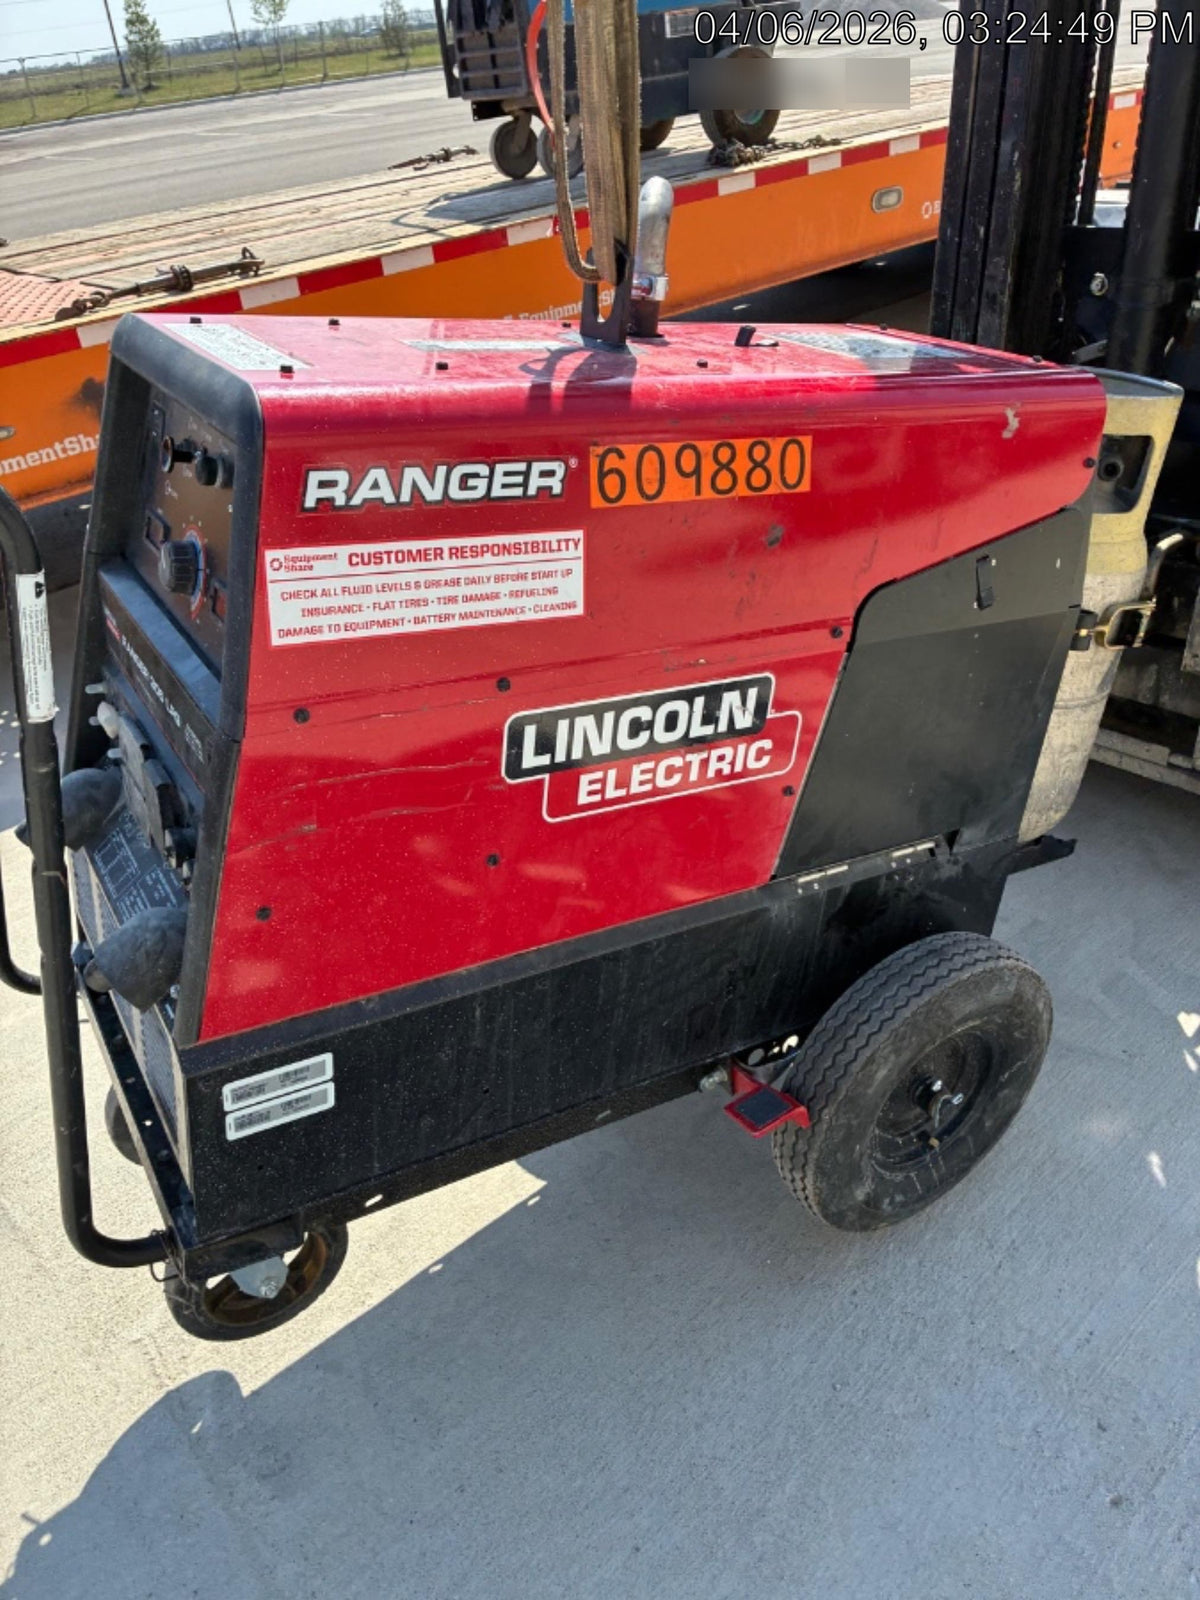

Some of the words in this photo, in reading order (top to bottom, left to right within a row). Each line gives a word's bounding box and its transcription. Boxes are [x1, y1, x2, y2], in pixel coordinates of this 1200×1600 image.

[303, 460, 566, 510] RANGER
[597, 437, 807, 505] 609880
[283, 552, 338, 564] Equipment
[283, 564, 314, 573] Share
[347, 546, 445, 568] CUSTOMER
[448, 537, 581, 561] RESPONSIBILITY
[280, 588, 318, 601] CHECK
[320, 587, 339, 599] ALL
[341, 584, 373, 596] FLUID
[375, 580, 411, 593] LEVELS
[414, 580, 421, 590] &
[424, 577, 462, 589] GREASE
[464, 575, 492, 586] DAILY
[493, 572, 529, 584] BEFORE
[531, 569, 558, 581] START
[560, 568, 573, 579] UP
[301, 604, 364, 618] INSURANCE
[372, 600, 396, 612] FLAT
[400, 597, 429, 609] TIRES
[436, 595, 459, 606] TIRE
[461, 591, 501, 604] DAMAGE
[508, 586, 559, 599] REFUELING
[277, 625, 324, 639] DAMAGE
[327, 623, 341, 634] TO
[344, 616, 405, 632] EQUIPMENT
[413, 612, 457, 625] BATTERY
[458, 606, 527, 621] MAINTENANCE
[532, 600, 578, 614] CLEANING
[520, 687, 759, 769] LINCOLN
[576, 738, 774, 806] ELECTRIC
